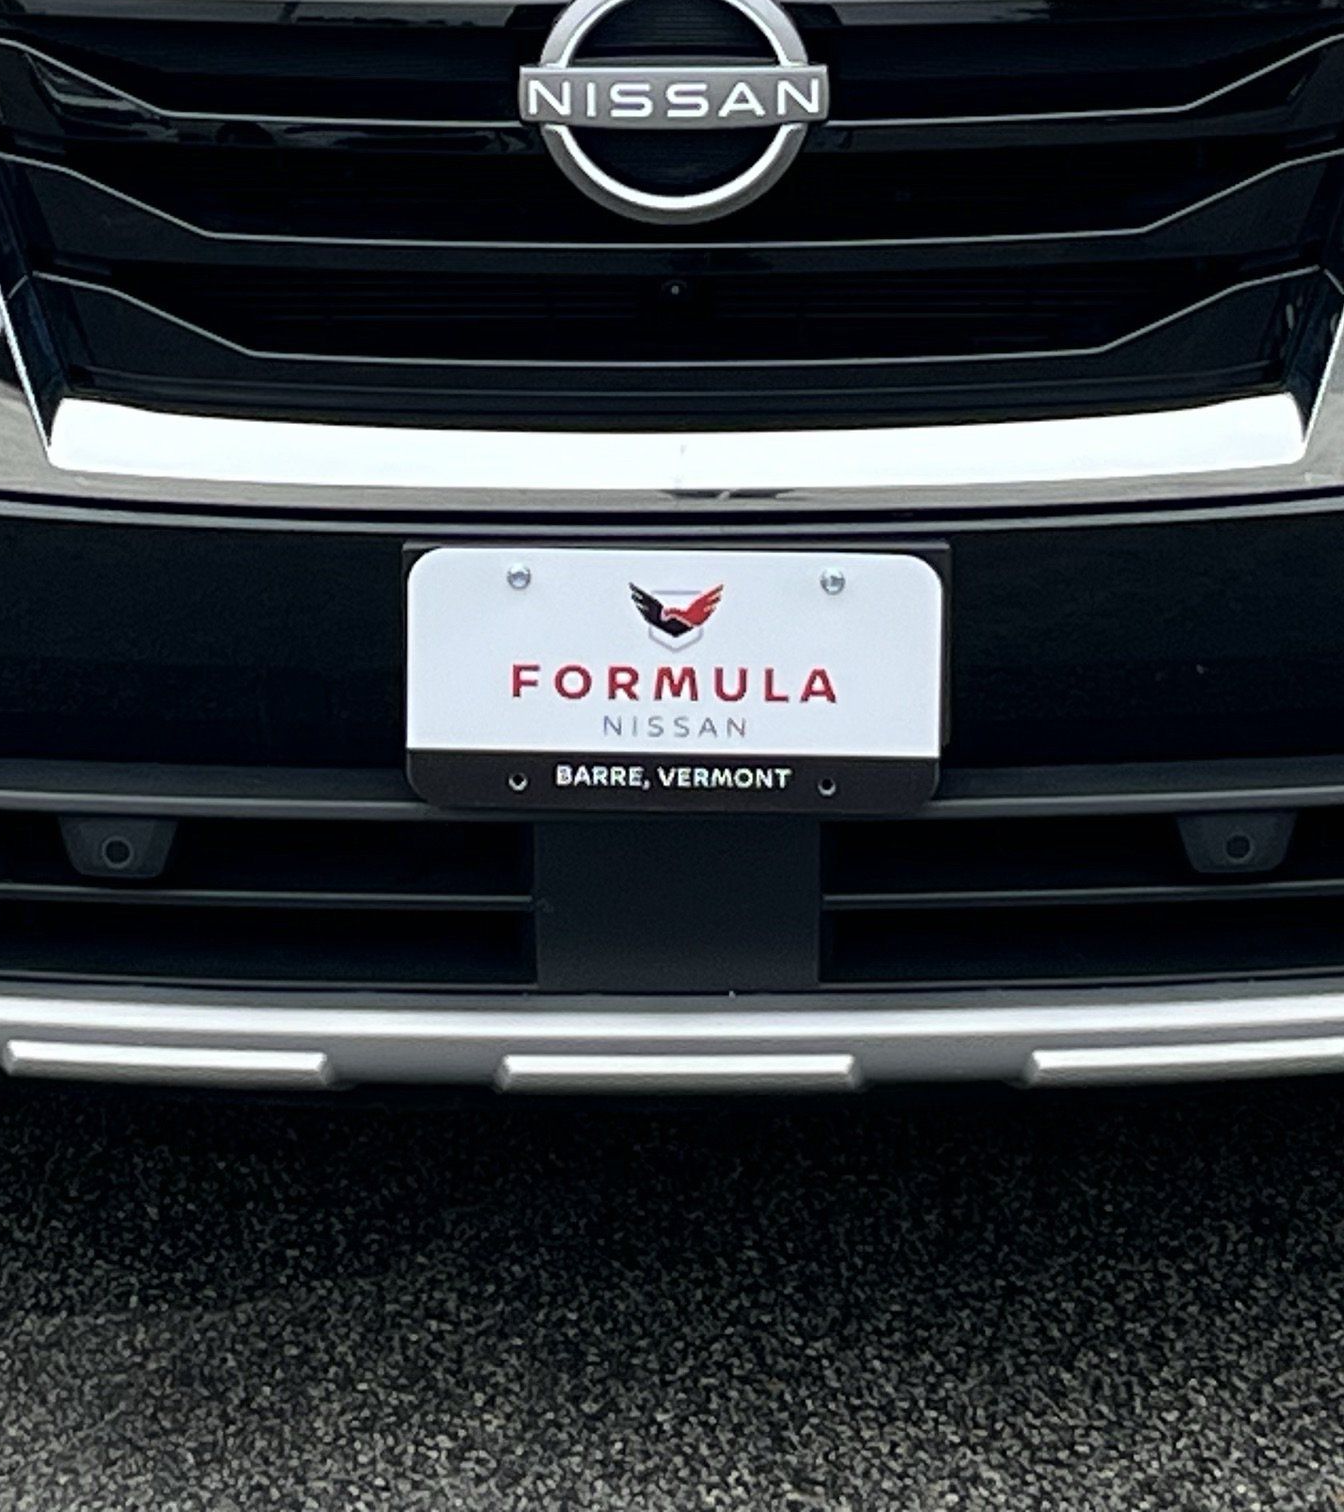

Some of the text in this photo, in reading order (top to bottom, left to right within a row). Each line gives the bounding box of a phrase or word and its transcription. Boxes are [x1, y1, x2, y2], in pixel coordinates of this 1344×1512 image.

[527, 79, 820, 118] NISSAN
[512, 664, 837, 703] FORMULA
[603, 714, 746, 738] NISSAN
[555, 763, 792, 790] BARRE, VERMONT
